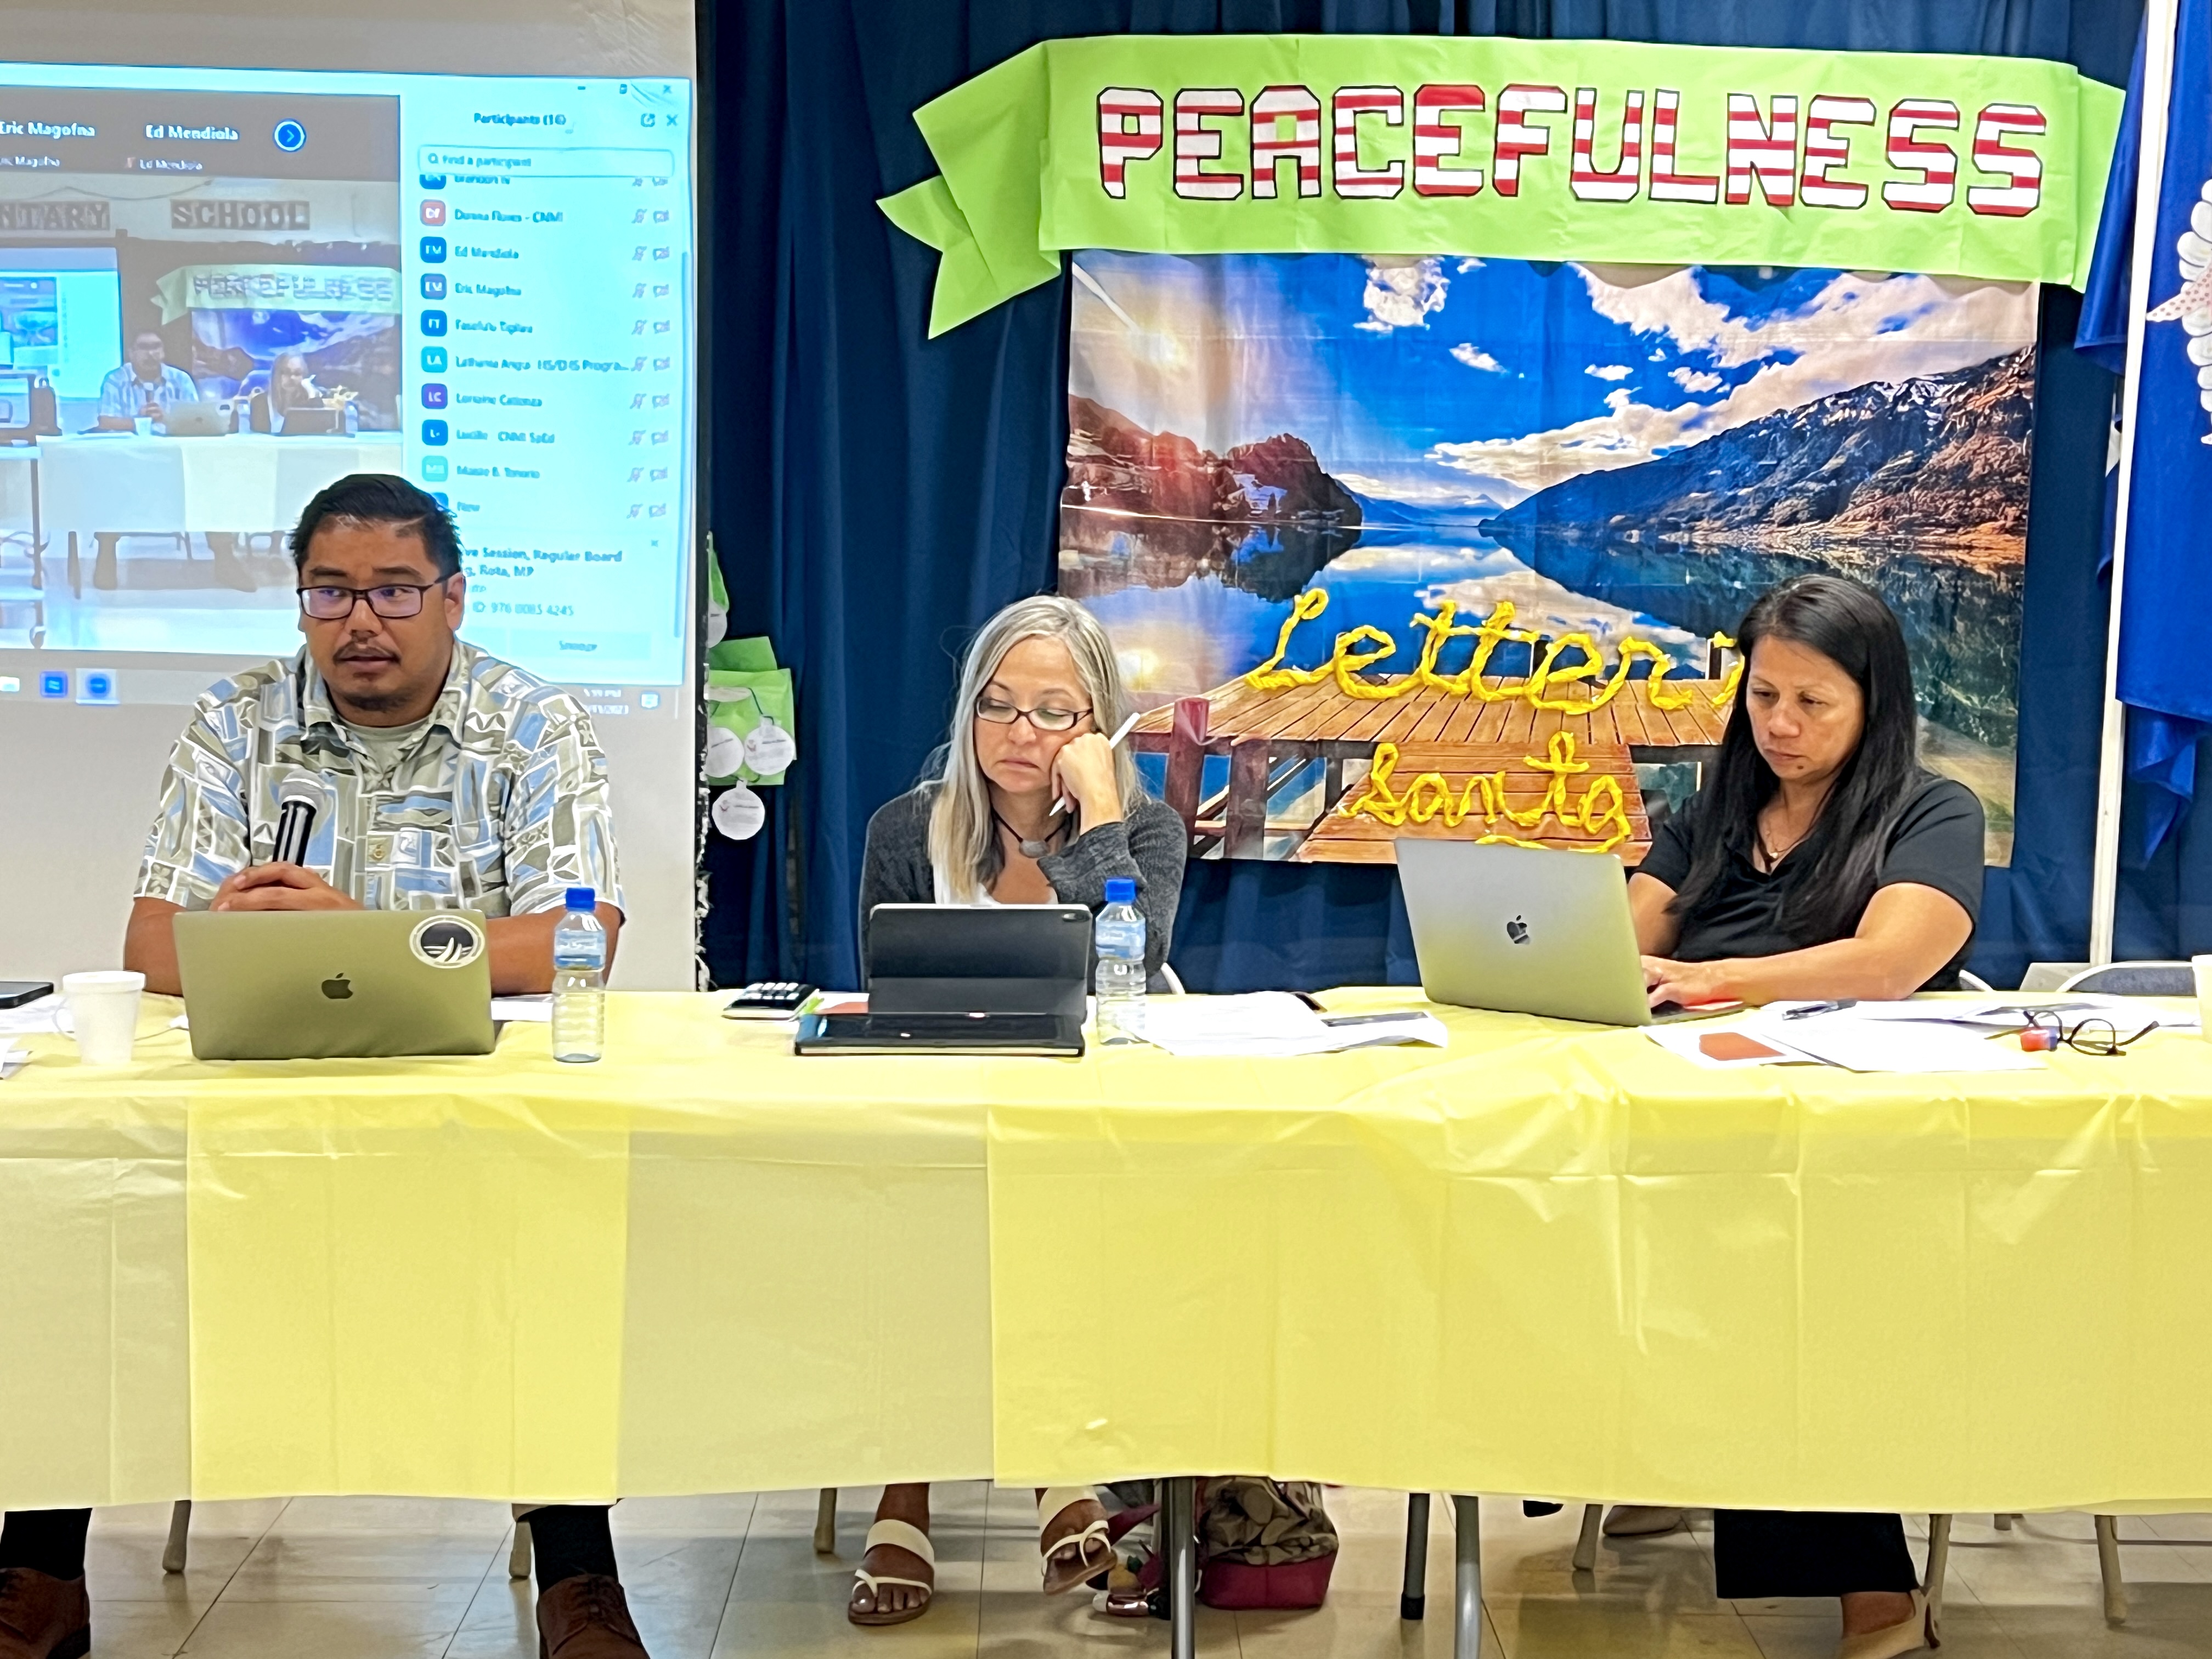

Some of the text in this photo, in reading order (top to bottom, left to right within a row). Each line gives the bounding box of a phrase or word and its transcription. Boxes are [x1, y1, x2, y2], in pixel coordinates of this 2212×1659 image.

[168, 126, 239, 140] Mendiola
[1097, 84, 2047, 217] PEACEFULNESS
[585, 550, 622, 562] Board
